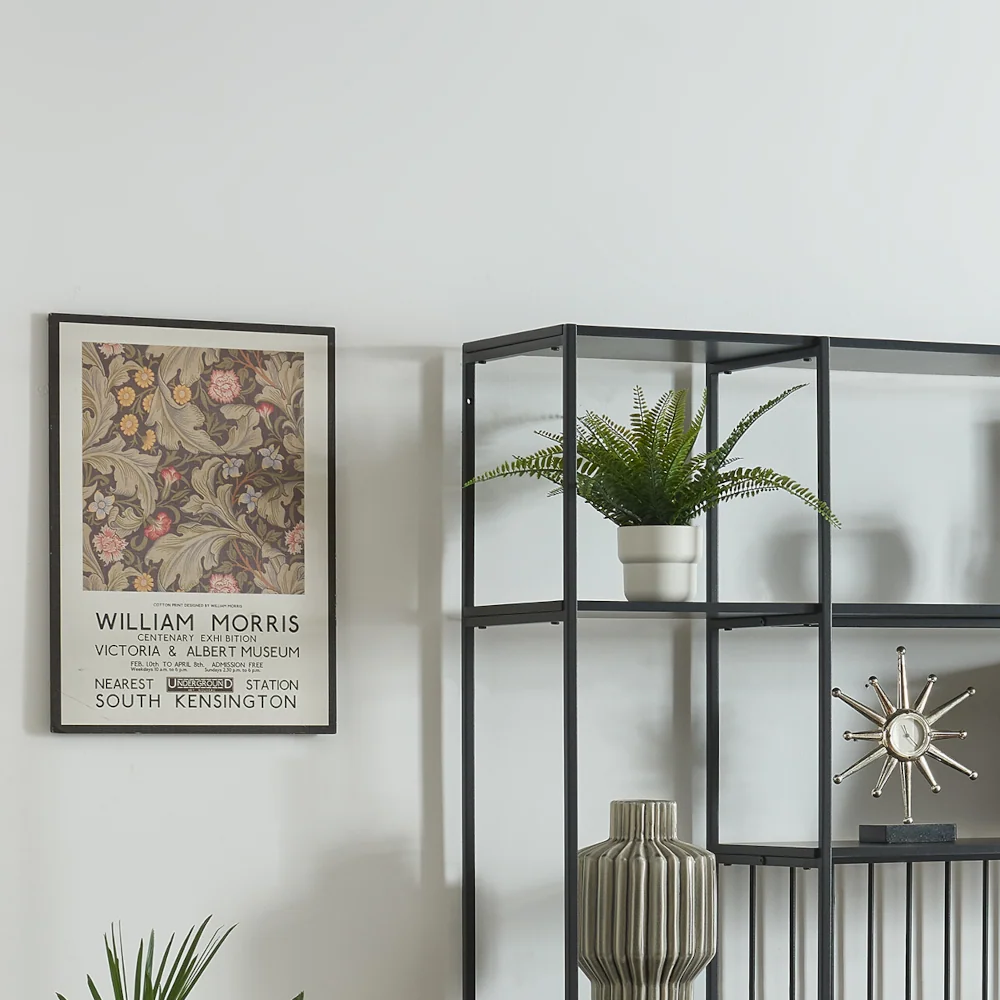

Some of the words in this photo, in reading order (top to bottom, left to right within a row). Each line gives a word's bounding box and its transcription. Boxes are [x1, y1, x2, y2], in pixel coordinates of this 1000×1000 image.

[95, 612, 194, 631] WILLIAM
[212, 614, 299, 633] MORRIS
[137, 633, 194, 642] CENTENARY
[95, 644, 161, 657] VICTORIA
[168, 645, 177, 657] &
[187, 645, 237, 657] ALBERT
[241, 646, 300, 658] MUSEUM
[95, 678, 154, 690] NEAREST
[167, 677, 233, 690] UNDERGROUND
[246, 679, 299, 691] STATION
[95, 693, 160, 708] SOUTH
[175, 694, 296, 709] KENSINGTON
